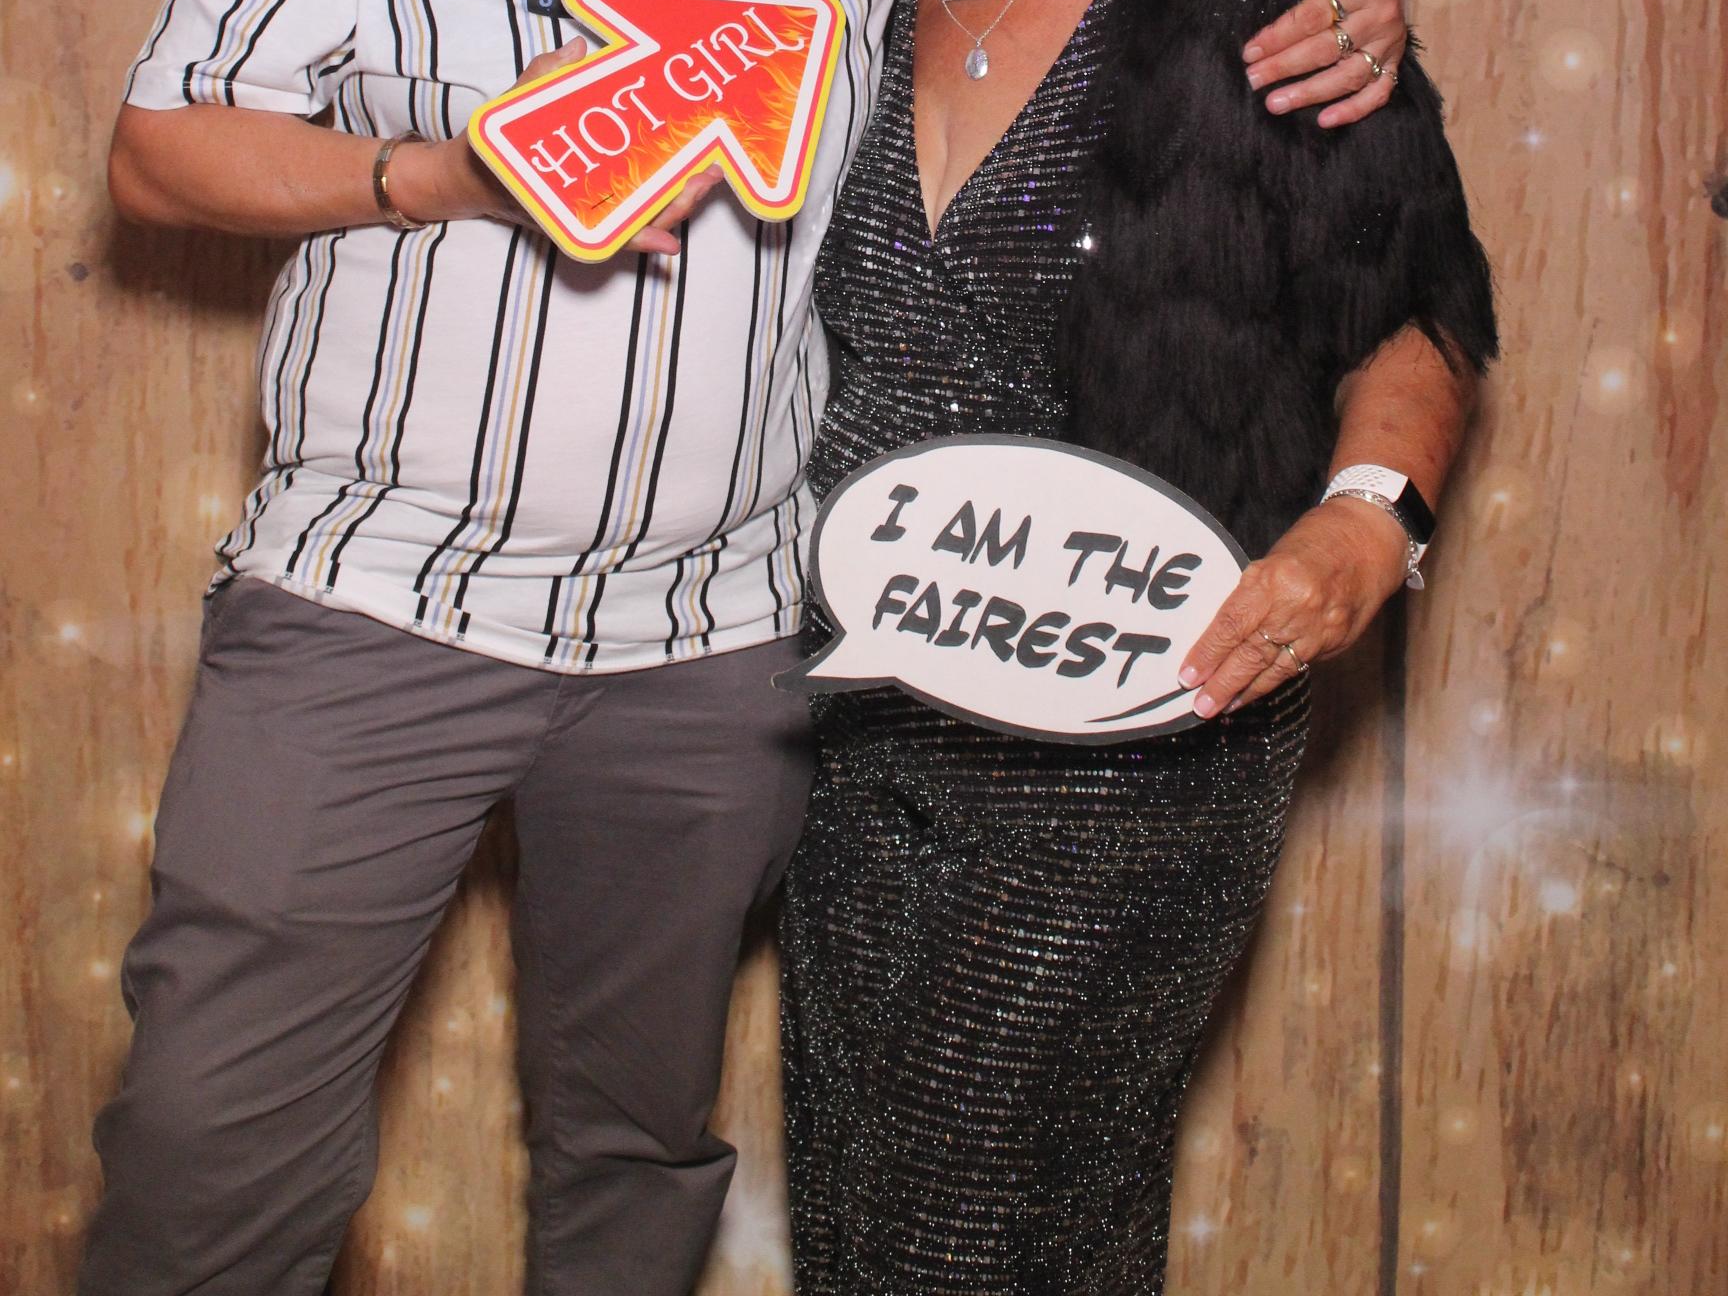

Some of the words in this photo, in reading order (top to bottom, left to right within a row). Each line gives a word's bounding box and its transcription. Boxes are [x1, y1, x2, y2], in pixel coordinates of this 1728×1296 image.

[530, 76, 666, 188] HOT
[663, 7, 806, 103] GIRL
[870, 483, 919, 542] I
[931, 500, 1032, 570] AM
[1063, 531, 1203, 611] THE
[872, 574, 1172, 689] FAIREST
